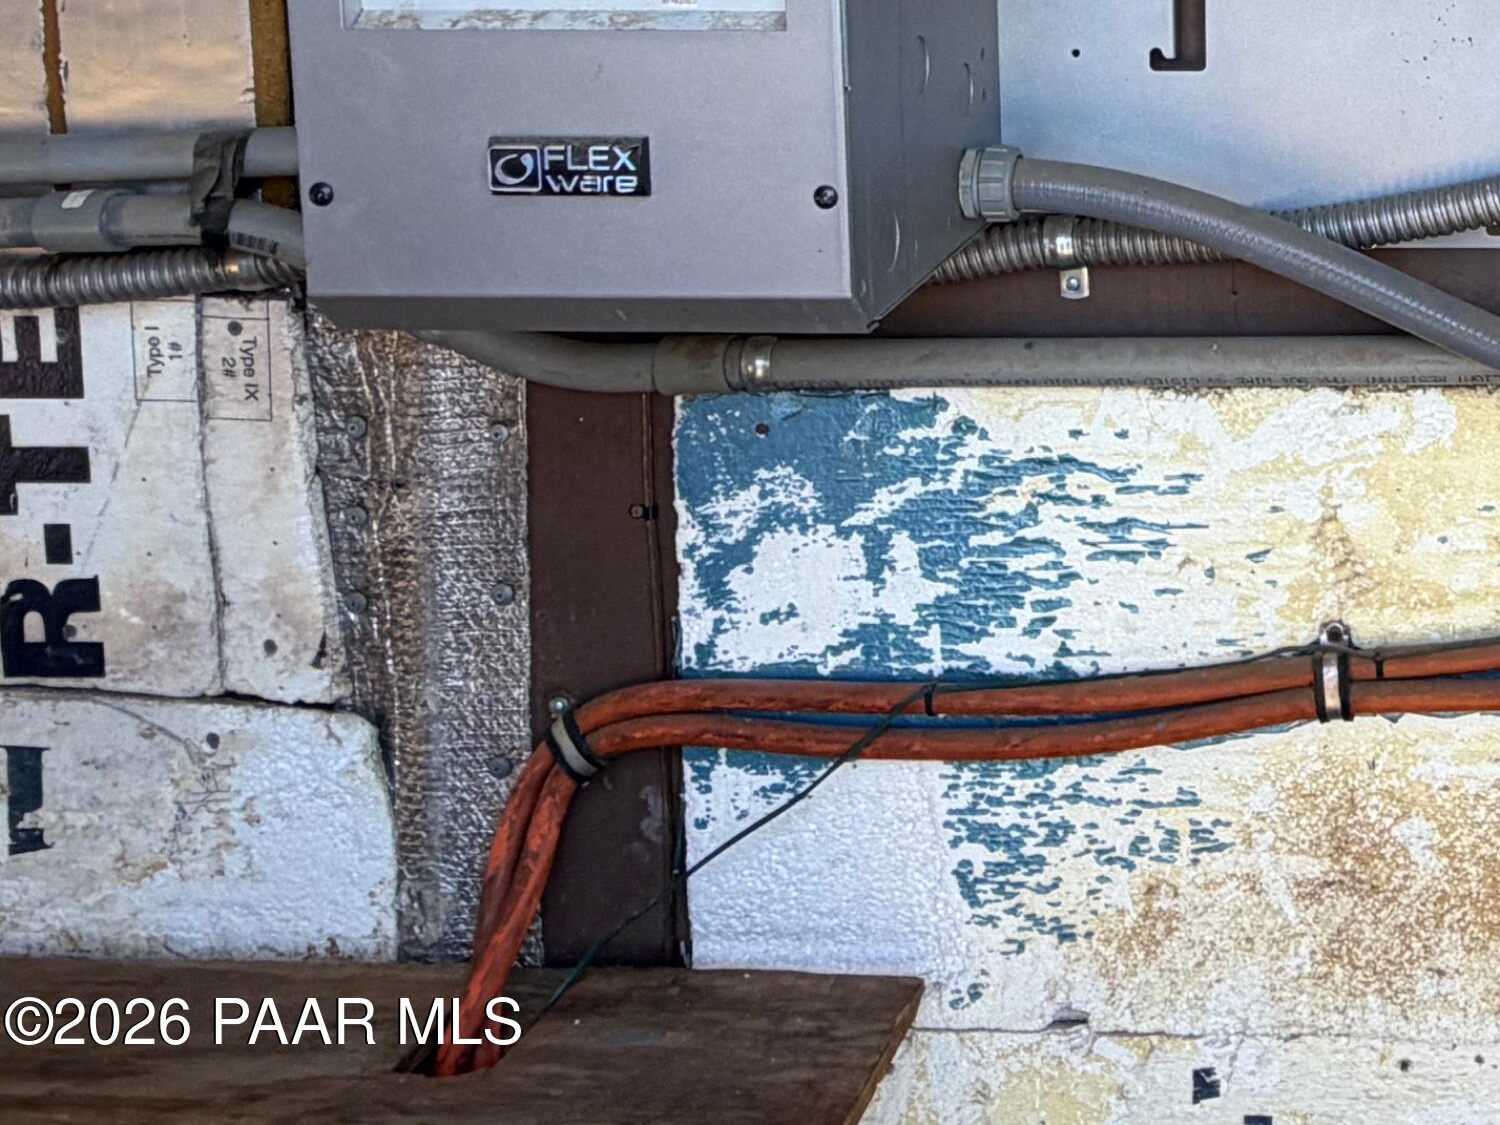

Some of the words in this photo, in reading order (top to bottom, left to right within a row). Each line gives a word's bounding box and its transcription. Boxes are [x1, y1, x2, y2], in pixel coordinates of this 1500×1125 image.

[543, 145, 640, 171] FLEX
[545, 175, 639, 193] ware
[146, 336, 165, 378] Type
[167, 341, 183, 361] 1#
[238, 336, 258, 378] Type
[221, 356, 237, 378] 2#
[244, 383, 260, 402] IX
